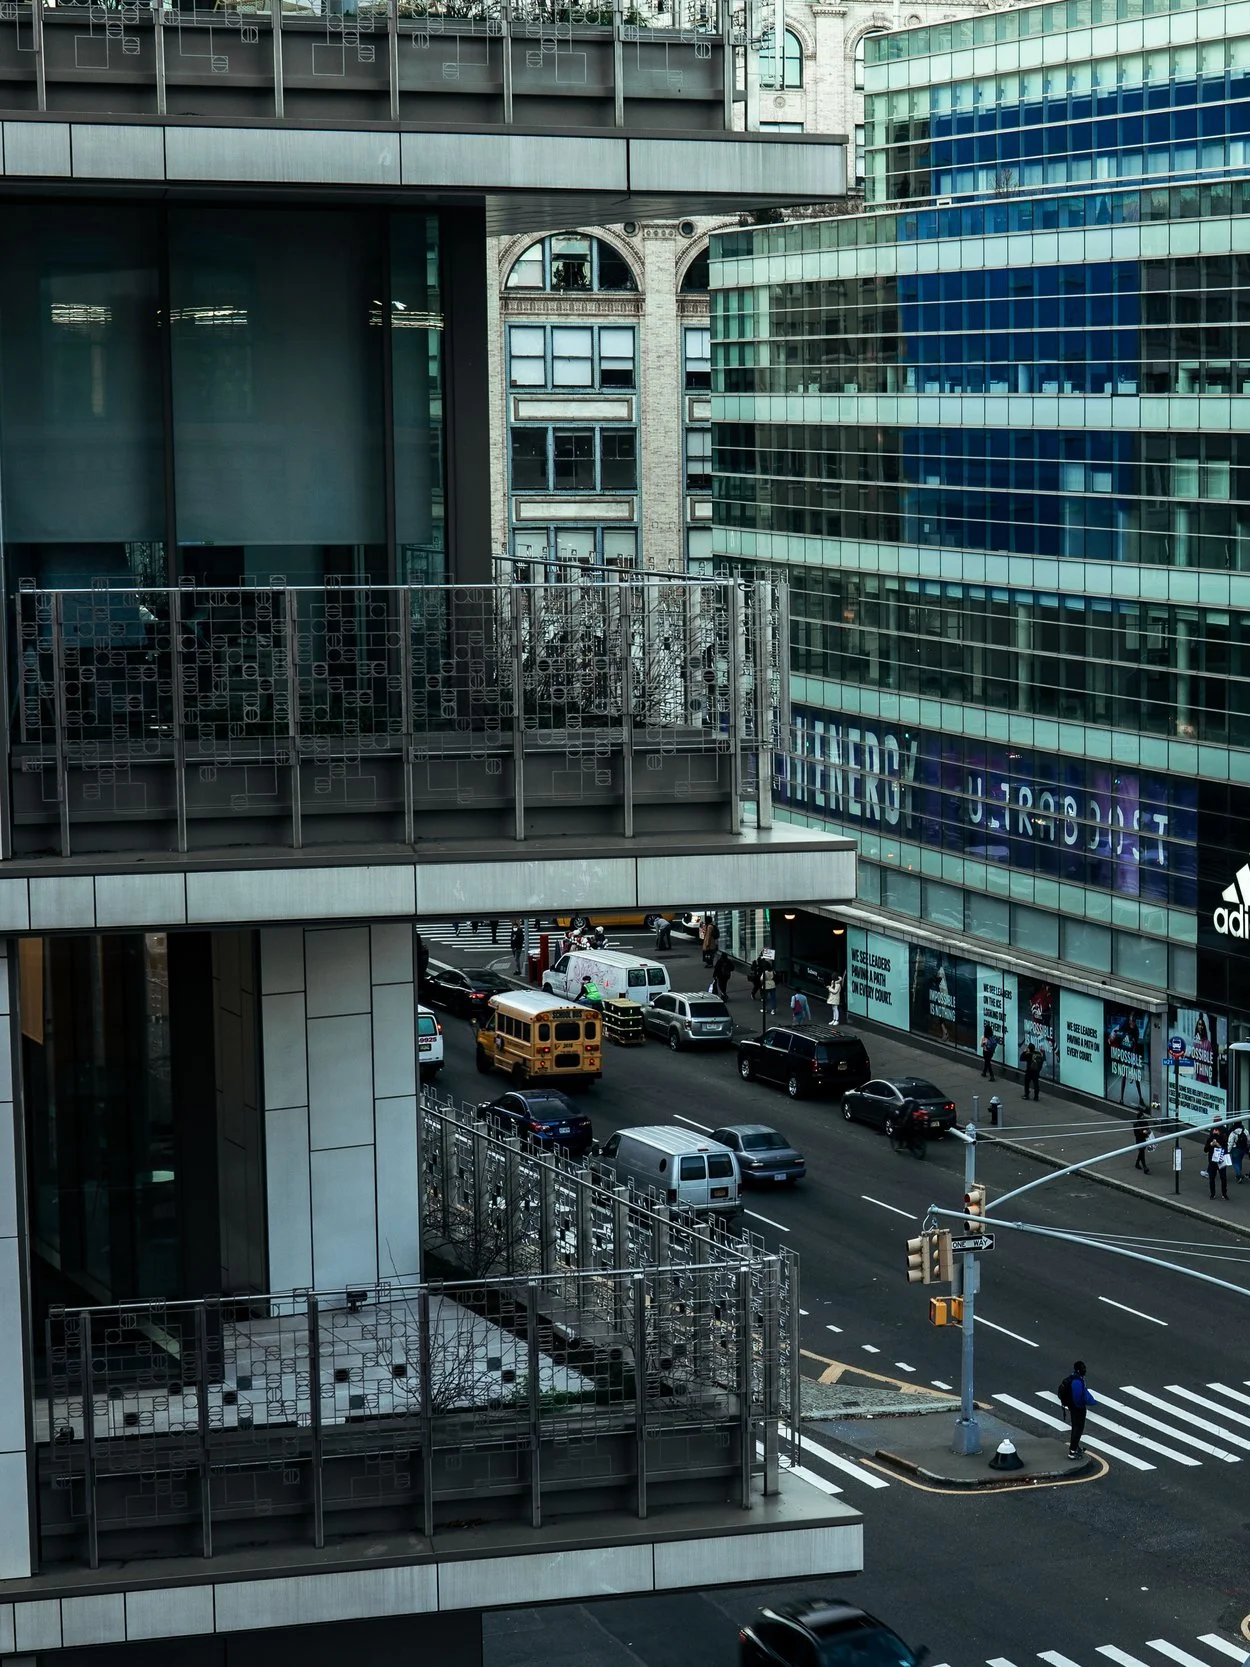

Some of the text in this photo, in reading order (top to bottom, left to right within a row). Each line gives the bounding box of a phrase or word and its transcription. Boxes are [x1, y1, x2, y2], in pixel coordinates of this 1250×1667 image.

[968, 775, 1168, 866] UTRABOOST
[869, 953, 891, 972] LEADERS
[552, 1010, 583, 1018] SCHOOL BUS
[1067, 1021, 1073, 1031] WE
[1081, 1025, 1098, 1039] LEADERS
[1067, 1046, 1078, 1058] EVERY
[1084, 1039, 1093, 1050] PATH
[1110, 1046, 1142, 1068] IMPOSSIBLE
[1111, 1061, 1117, 1074] IS
